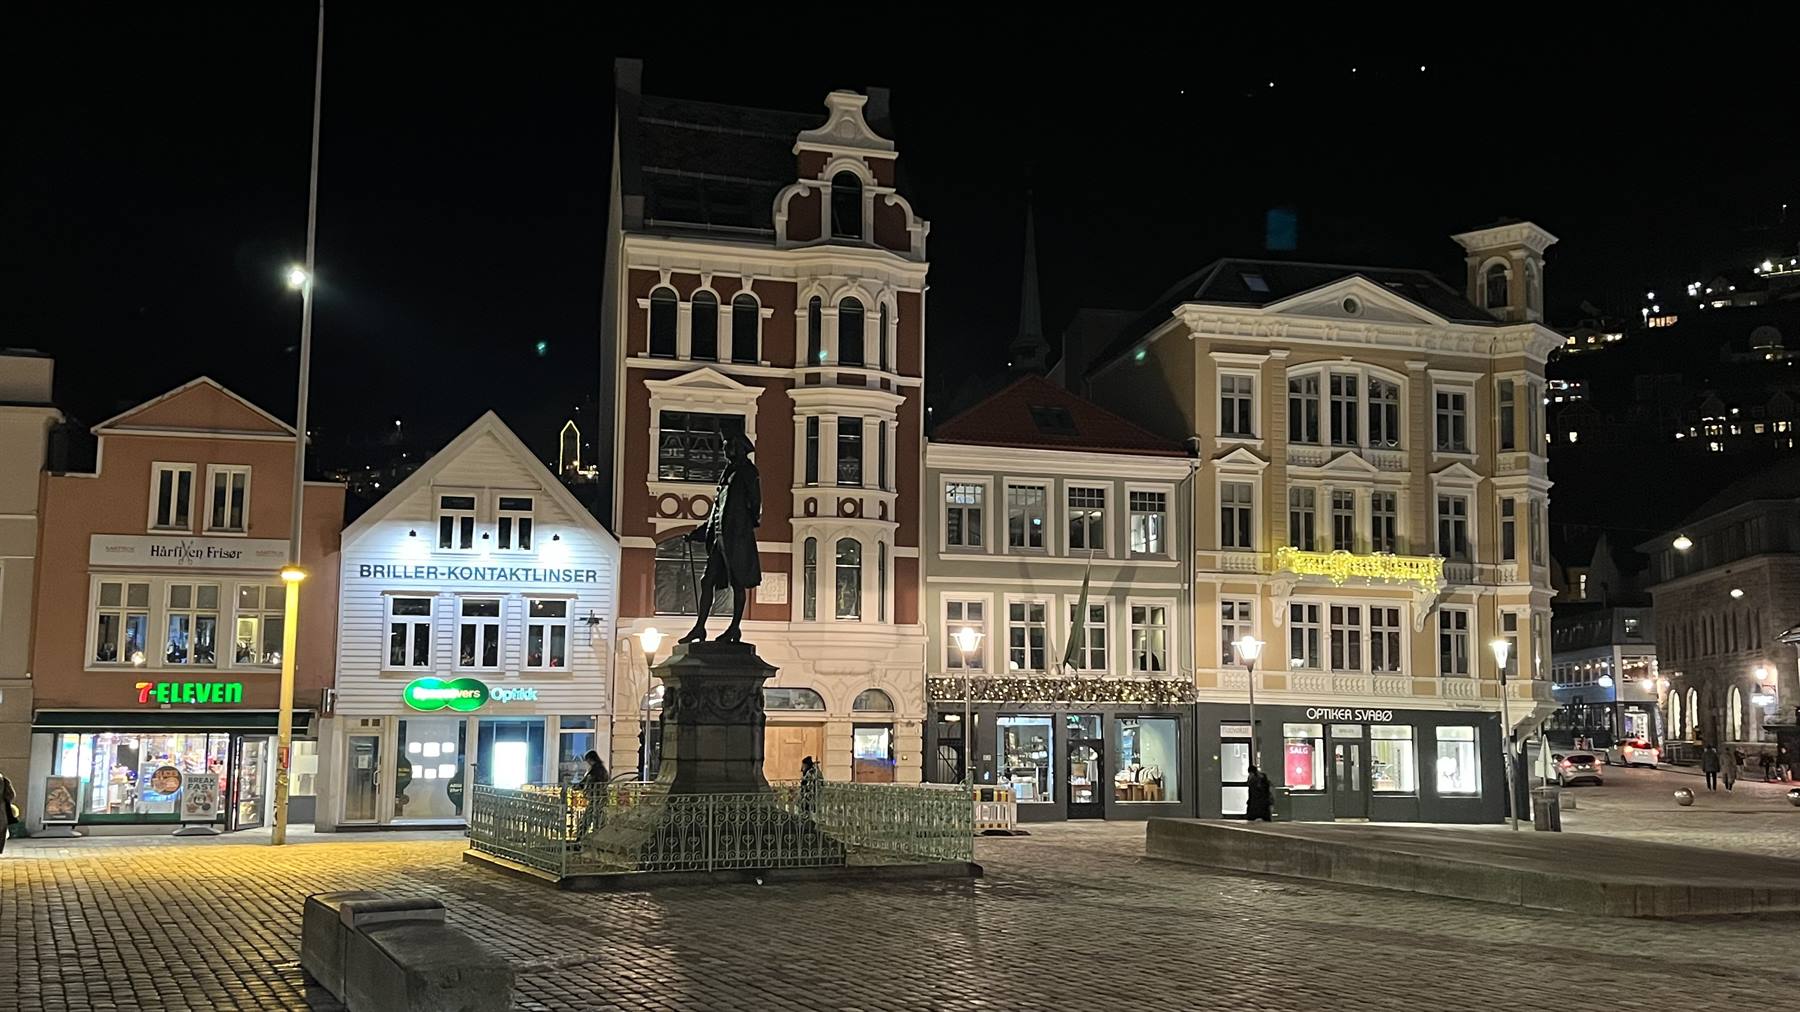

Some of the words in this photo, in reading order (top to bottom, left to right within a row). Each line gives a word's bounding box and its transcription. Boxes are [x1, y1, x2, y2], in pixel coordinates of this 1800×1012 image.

[207, 545, 243, 559] Frisør
[359, 563, 597, 583] BRILLER-KONTAKTLINSER
[490, 686, 538, 703] Optikk
[1306, 707, 1353, 721] OPTIKER
[1354, 708, 1393, 722] SVABØ
[1289, 746, 1309, 755] SALG
